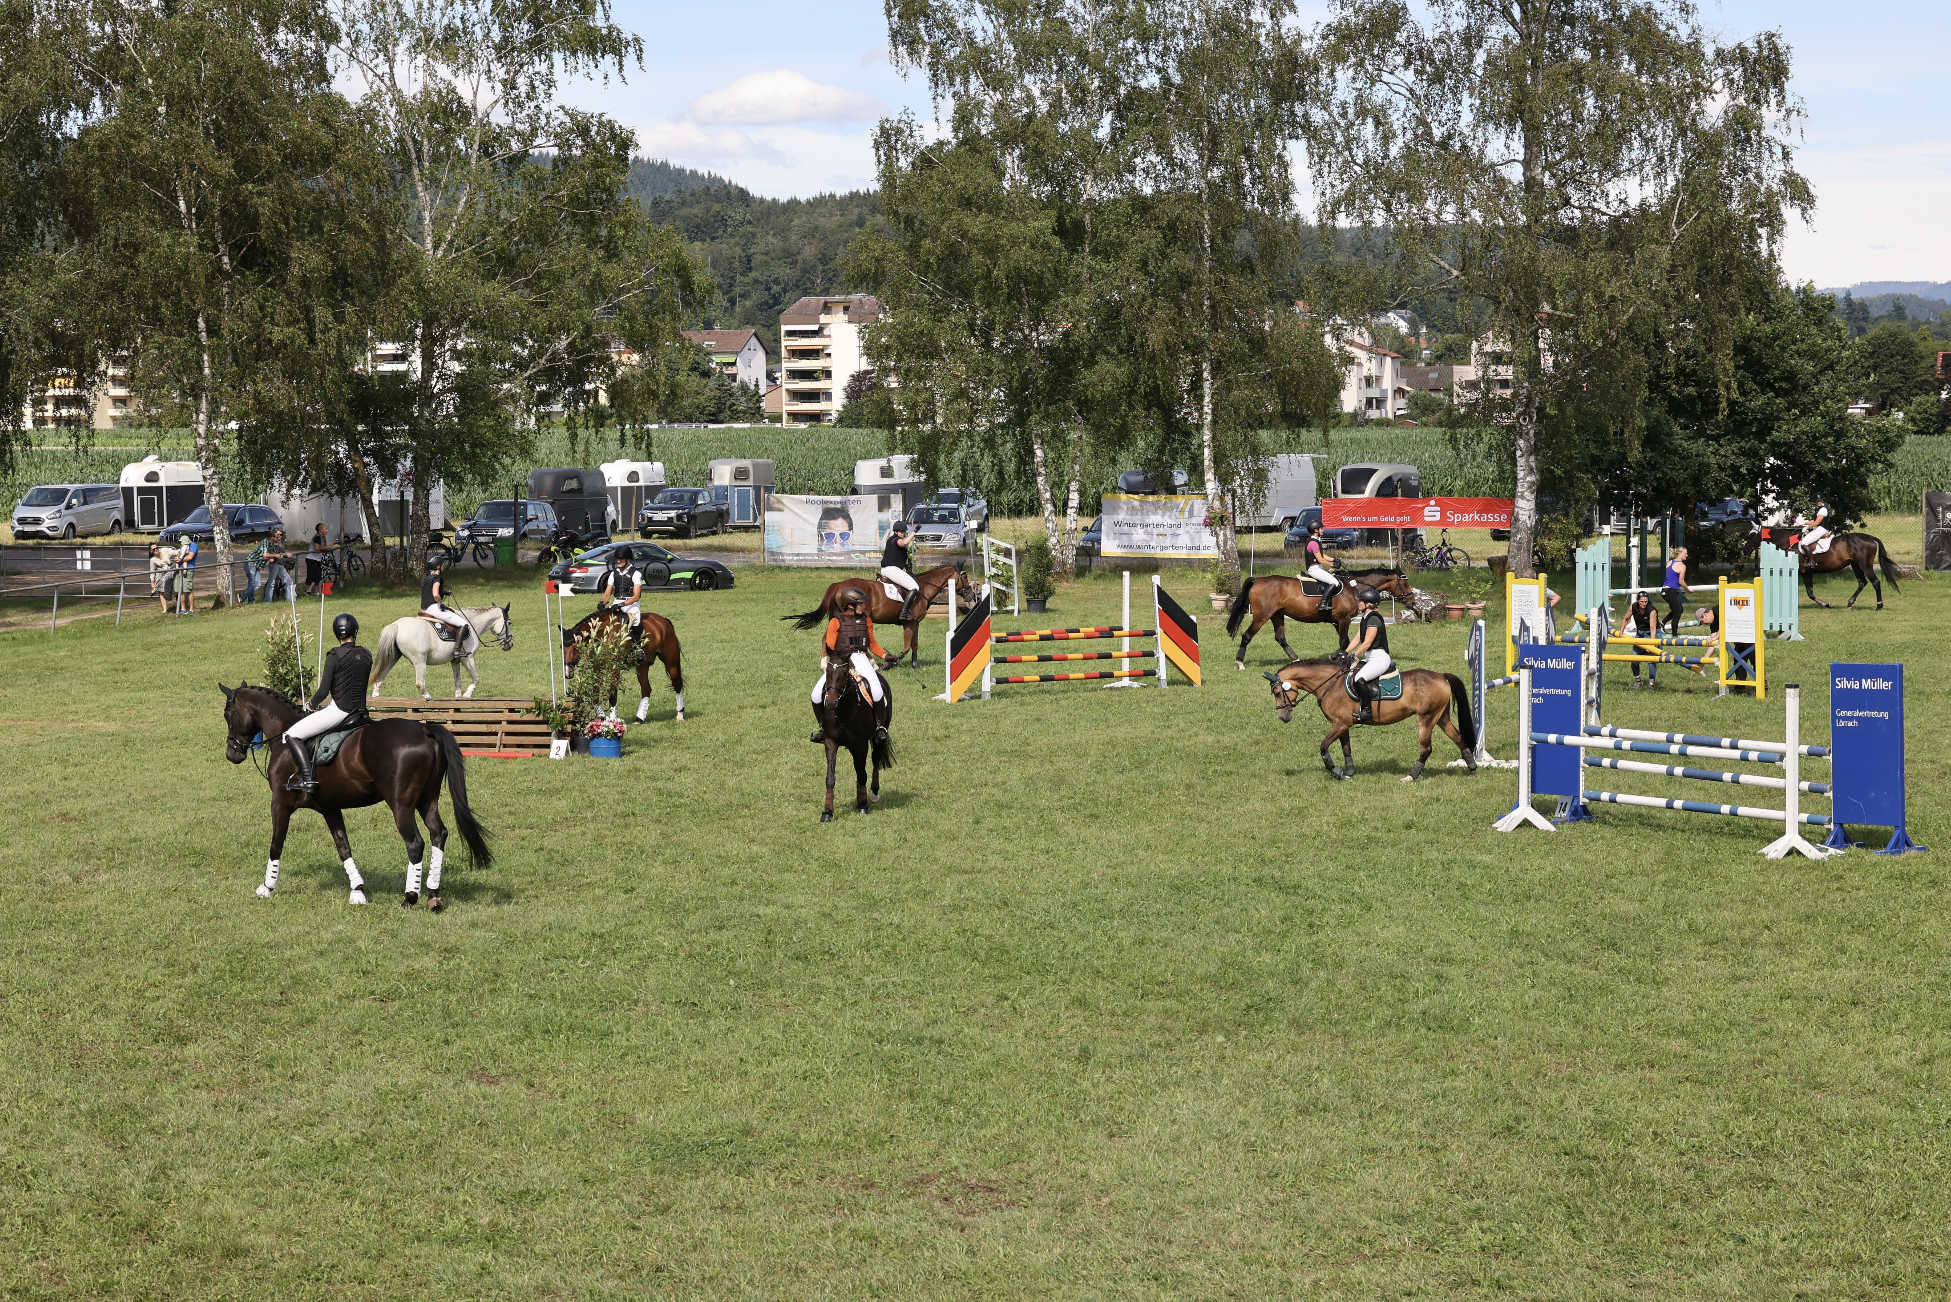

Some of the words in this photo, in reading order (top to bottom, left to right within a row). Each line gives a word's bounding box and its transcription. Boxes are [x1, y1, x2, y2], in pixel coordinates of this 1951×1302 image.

[805, 498, 862, 506] Poolexperten
[1342, 514, 1366, 522] Wenn's
[1380, 514, 1395, 522] Geld
[1396, 515, 1411, 524] geht
[1446, 510, 1508, 524] Sparkasse
[1113, 520, 1182, 529] Wintergarten-land
[1116, 543, 1212, 552] www.wintergarten-land.de
[1523, 656, 1546, 669] Silvia
[1547, 657, 1576, 670] Müller
[1835, 677, 1860, 690] Silvia
[1861, 677, 1893, 690] Müller
[1531, 696, 1544, 704] rach
[1835, 708, 1889, 720] Generalvertretung
[1836, 719, 1858, 727] Lörrach
[555, 745, 561, 756] 2
[1558, 802, 1568, 813] 14
